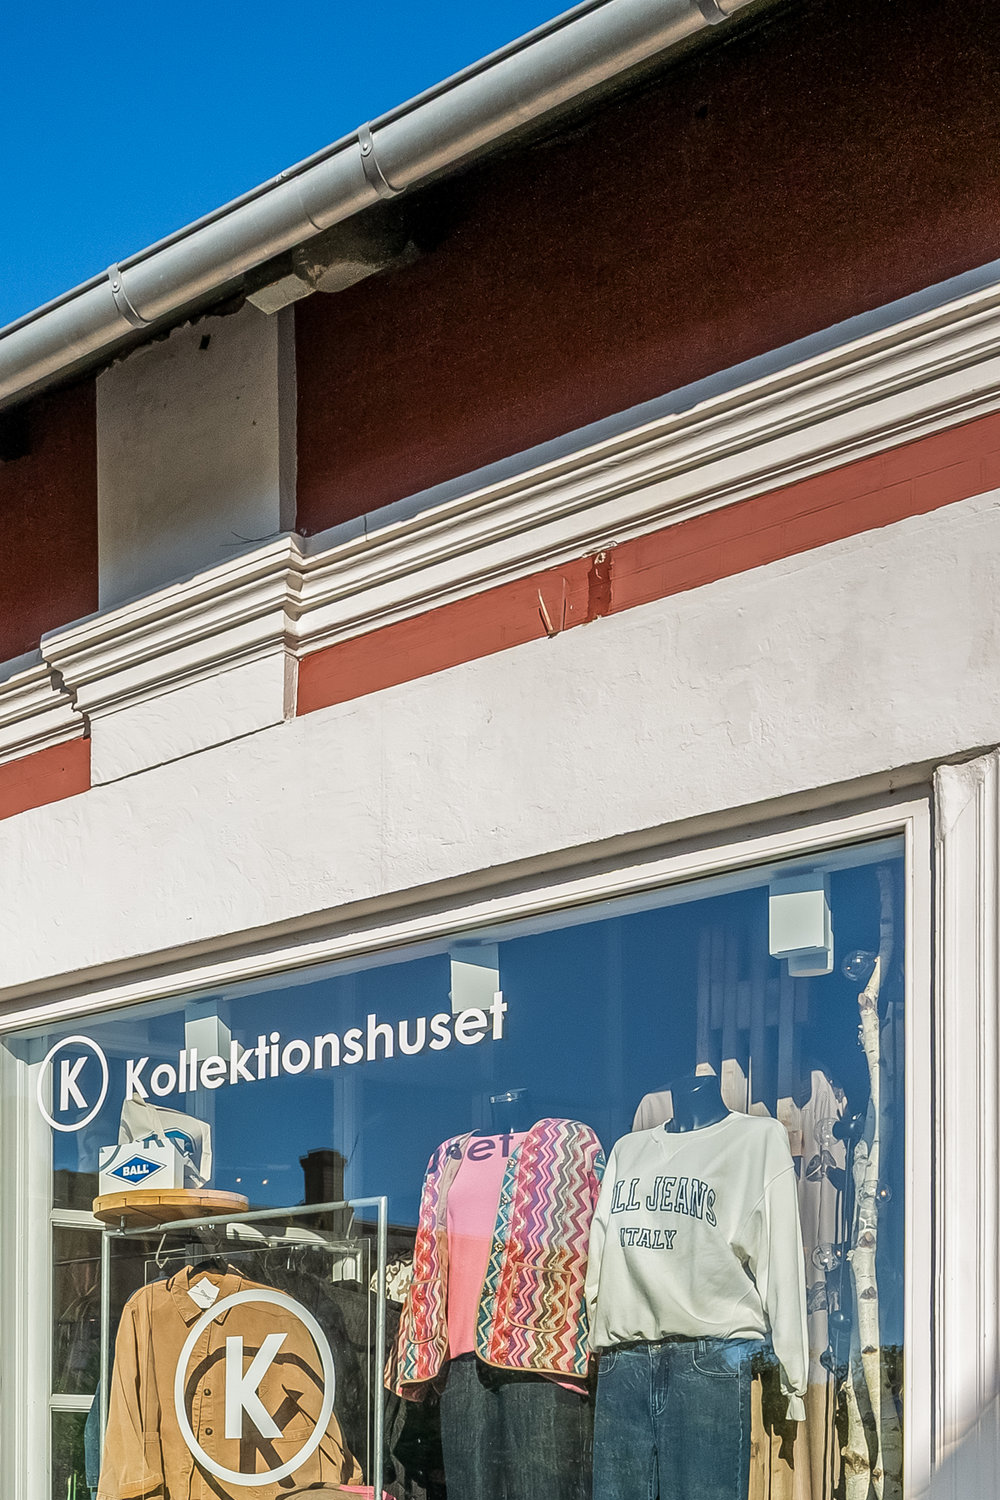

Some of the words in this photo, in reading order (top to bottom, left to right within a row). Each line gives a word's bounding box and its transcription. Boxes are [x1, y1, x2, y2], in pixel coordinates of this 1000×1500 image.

[58, 1055, 90, 1112] K
[125, 991, 509, 1101] Kollektionshuset
[122, 1164, 149, 1177] BALL
[611, 1178, 640, 1214] LL
[645, 1176, 717, 1227] JEANS
[620, 1227, 677, 1250] ITALY
[224, 1333, 288, 1440] K
